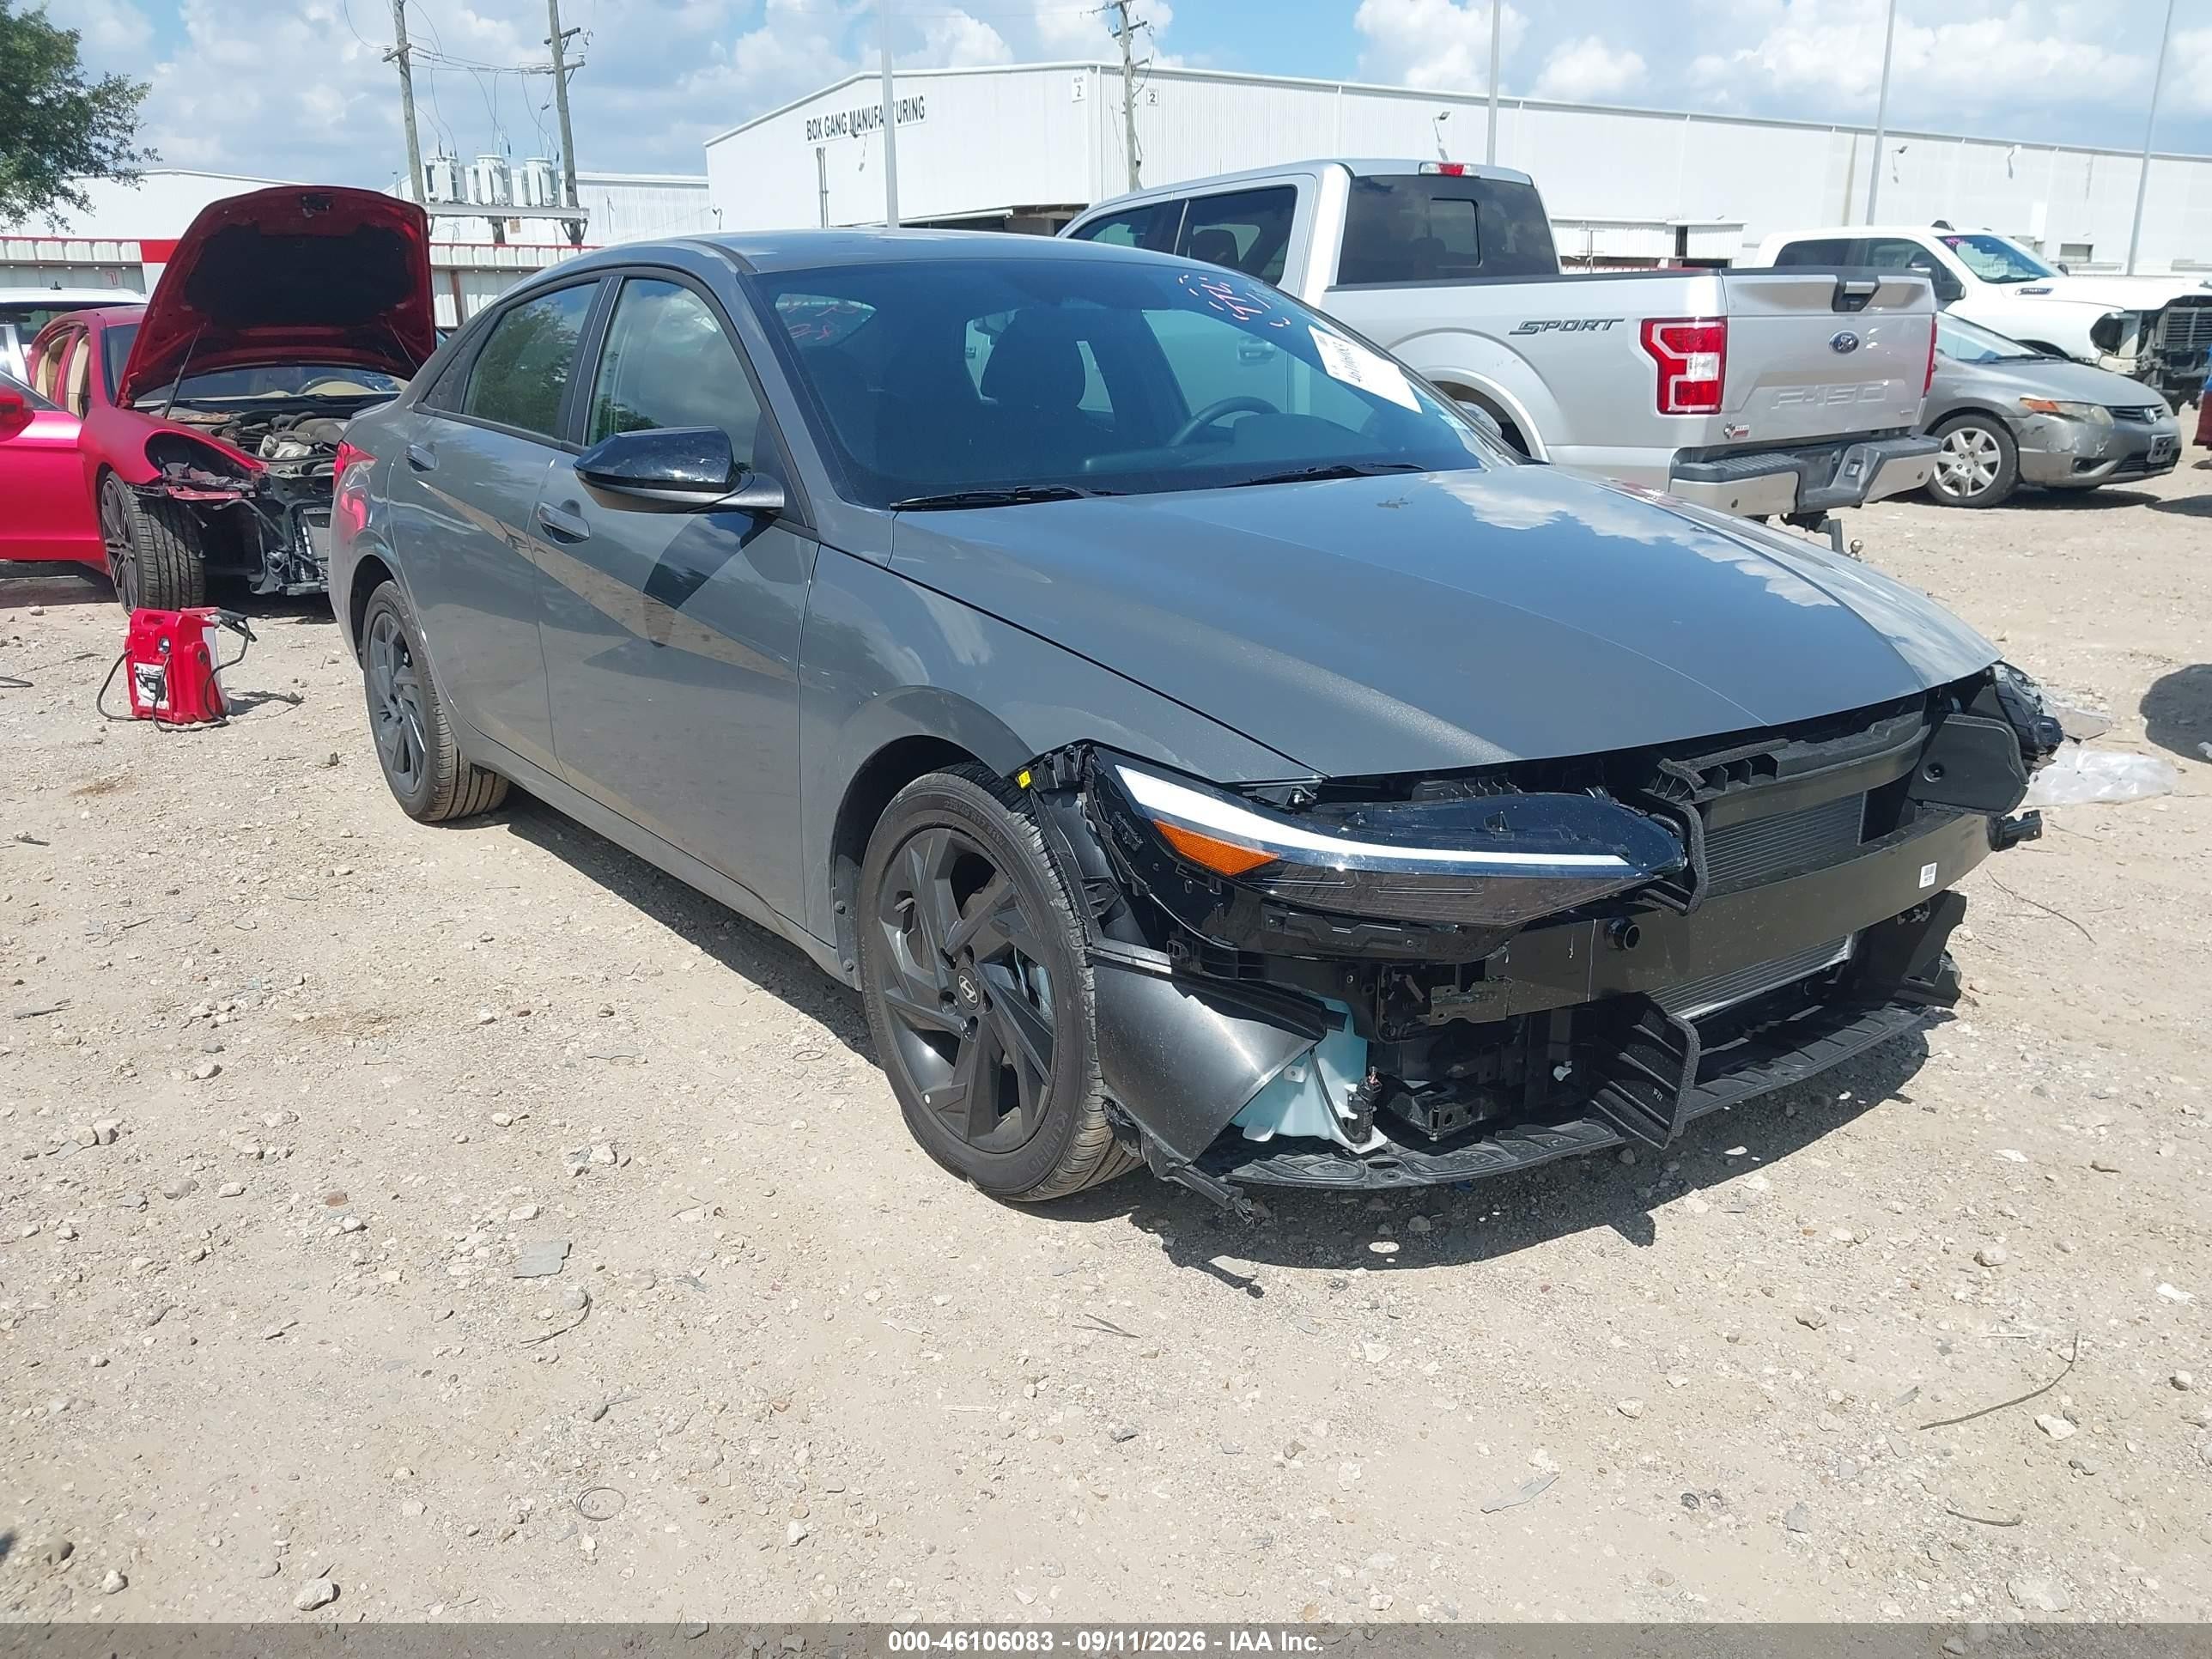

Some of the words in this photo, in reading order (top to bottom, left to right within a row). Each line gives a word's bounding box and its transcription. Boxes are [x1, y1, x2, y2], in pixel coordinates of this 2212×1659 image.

[1077, 85, 1082, 97] 2
[1150, 93, 1156, 103] 2
[806, 117, 823, 141] BOX
[824, 112, 848, 138] GANG
[849, 94, 925, 131] MANUFAURING
[1509, 318, 1626, 336] SPORT
[1771, 383, 1888, 410] F-150
